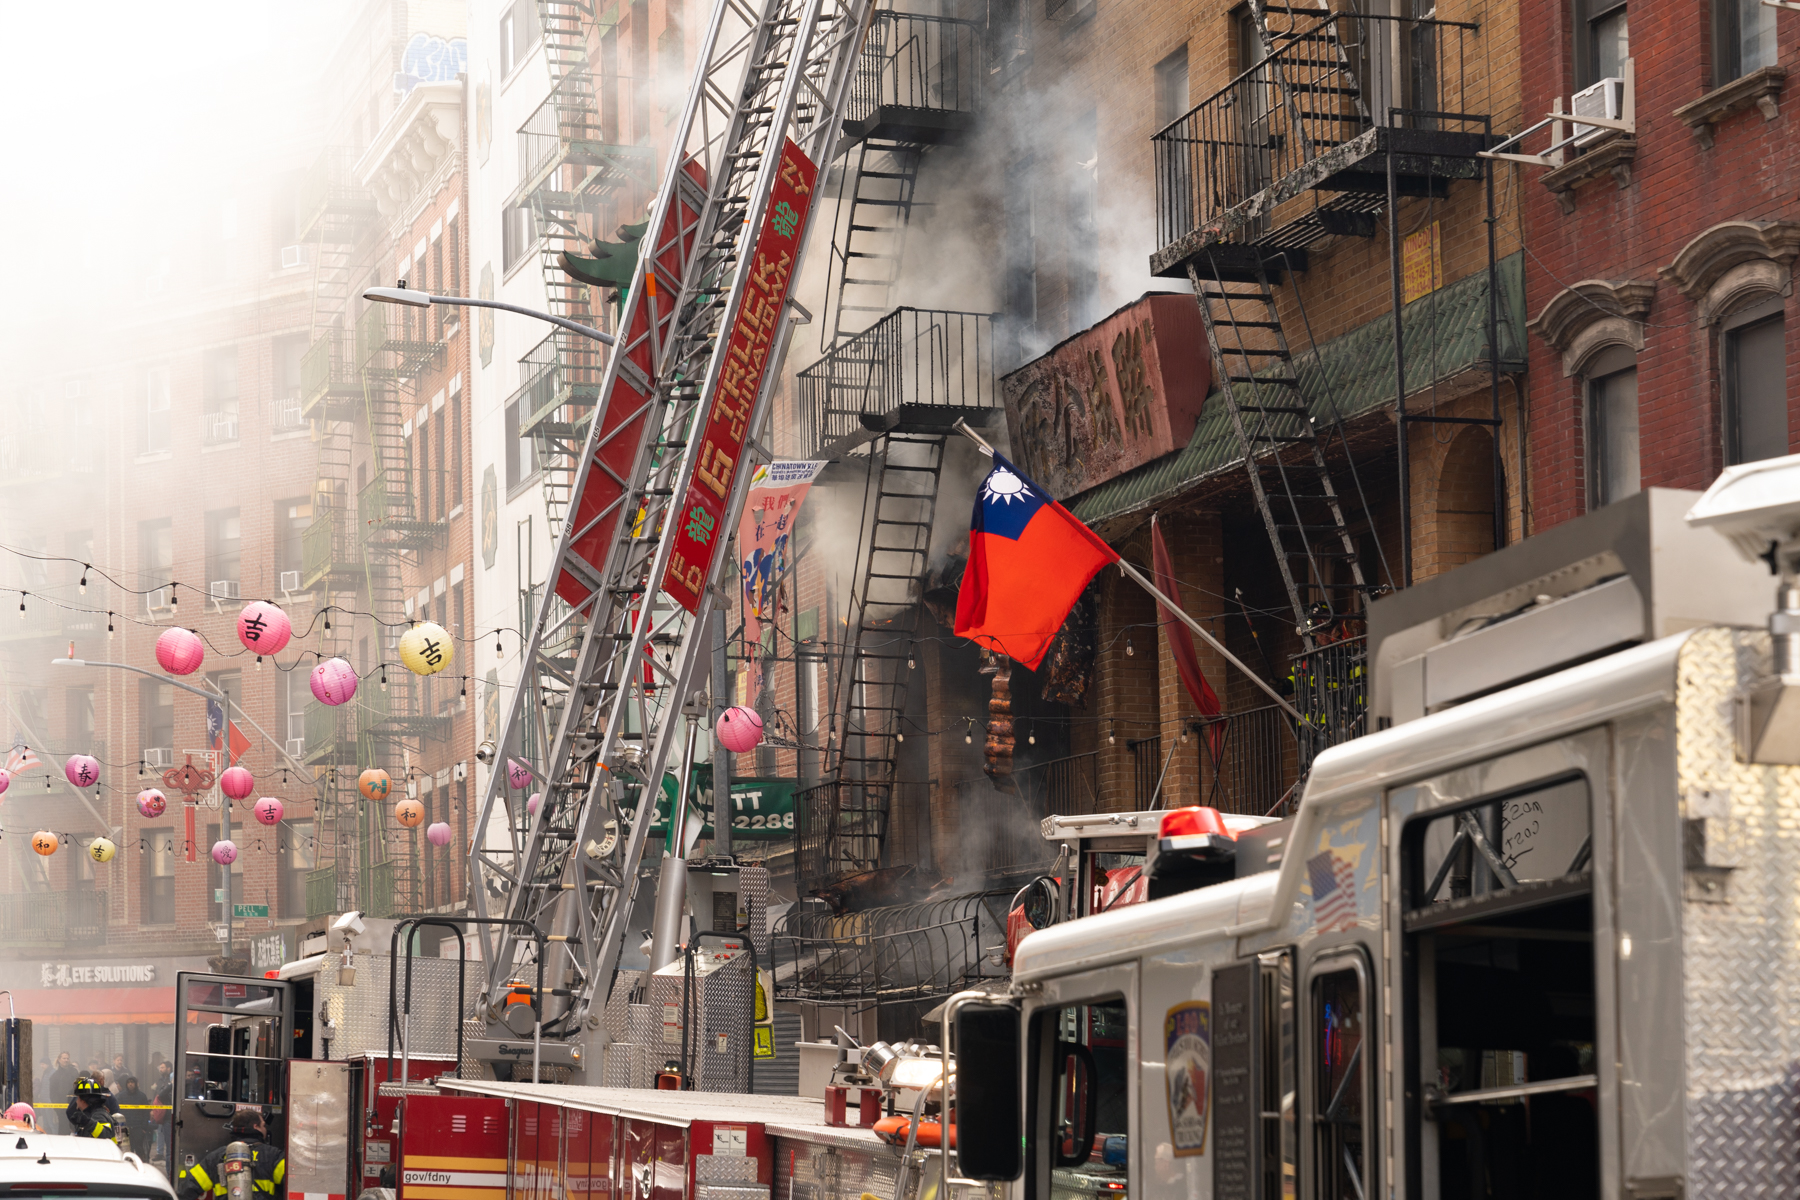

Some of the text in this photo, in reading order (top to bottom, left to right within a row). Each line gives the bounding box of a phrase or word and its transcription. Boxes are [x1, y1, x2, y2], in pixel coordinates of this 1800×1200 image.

[771, 200, 799, 240] 龍
[713, 252, 776, 424] TRUCK
[729, 250, 791, 444] CHINATOWN
[698, 439, 734, 499] 6
[684, 506, 715, 546] 龍
[244, 613, 268, 642] 吉
[419, 638, 443, 666] 吉
[78, 764, 93, 783] 春
[511, 766, 528, 781] 和
[696, 785, 763, 811] MTT
[263, 805, 277, 821] 吉
[401, 808, 417, 822] 和
[94, 845, 105, 858] 吉
[238, 905, 255, 913] PELL
[72, 965, 155, 982] EYE SOLUTIONS
[498, 1044, 534, 1059] Seagrav
[225, 1161, 240, 1172] L-6
[405, 1171, 451, 1184] gov/fdny
